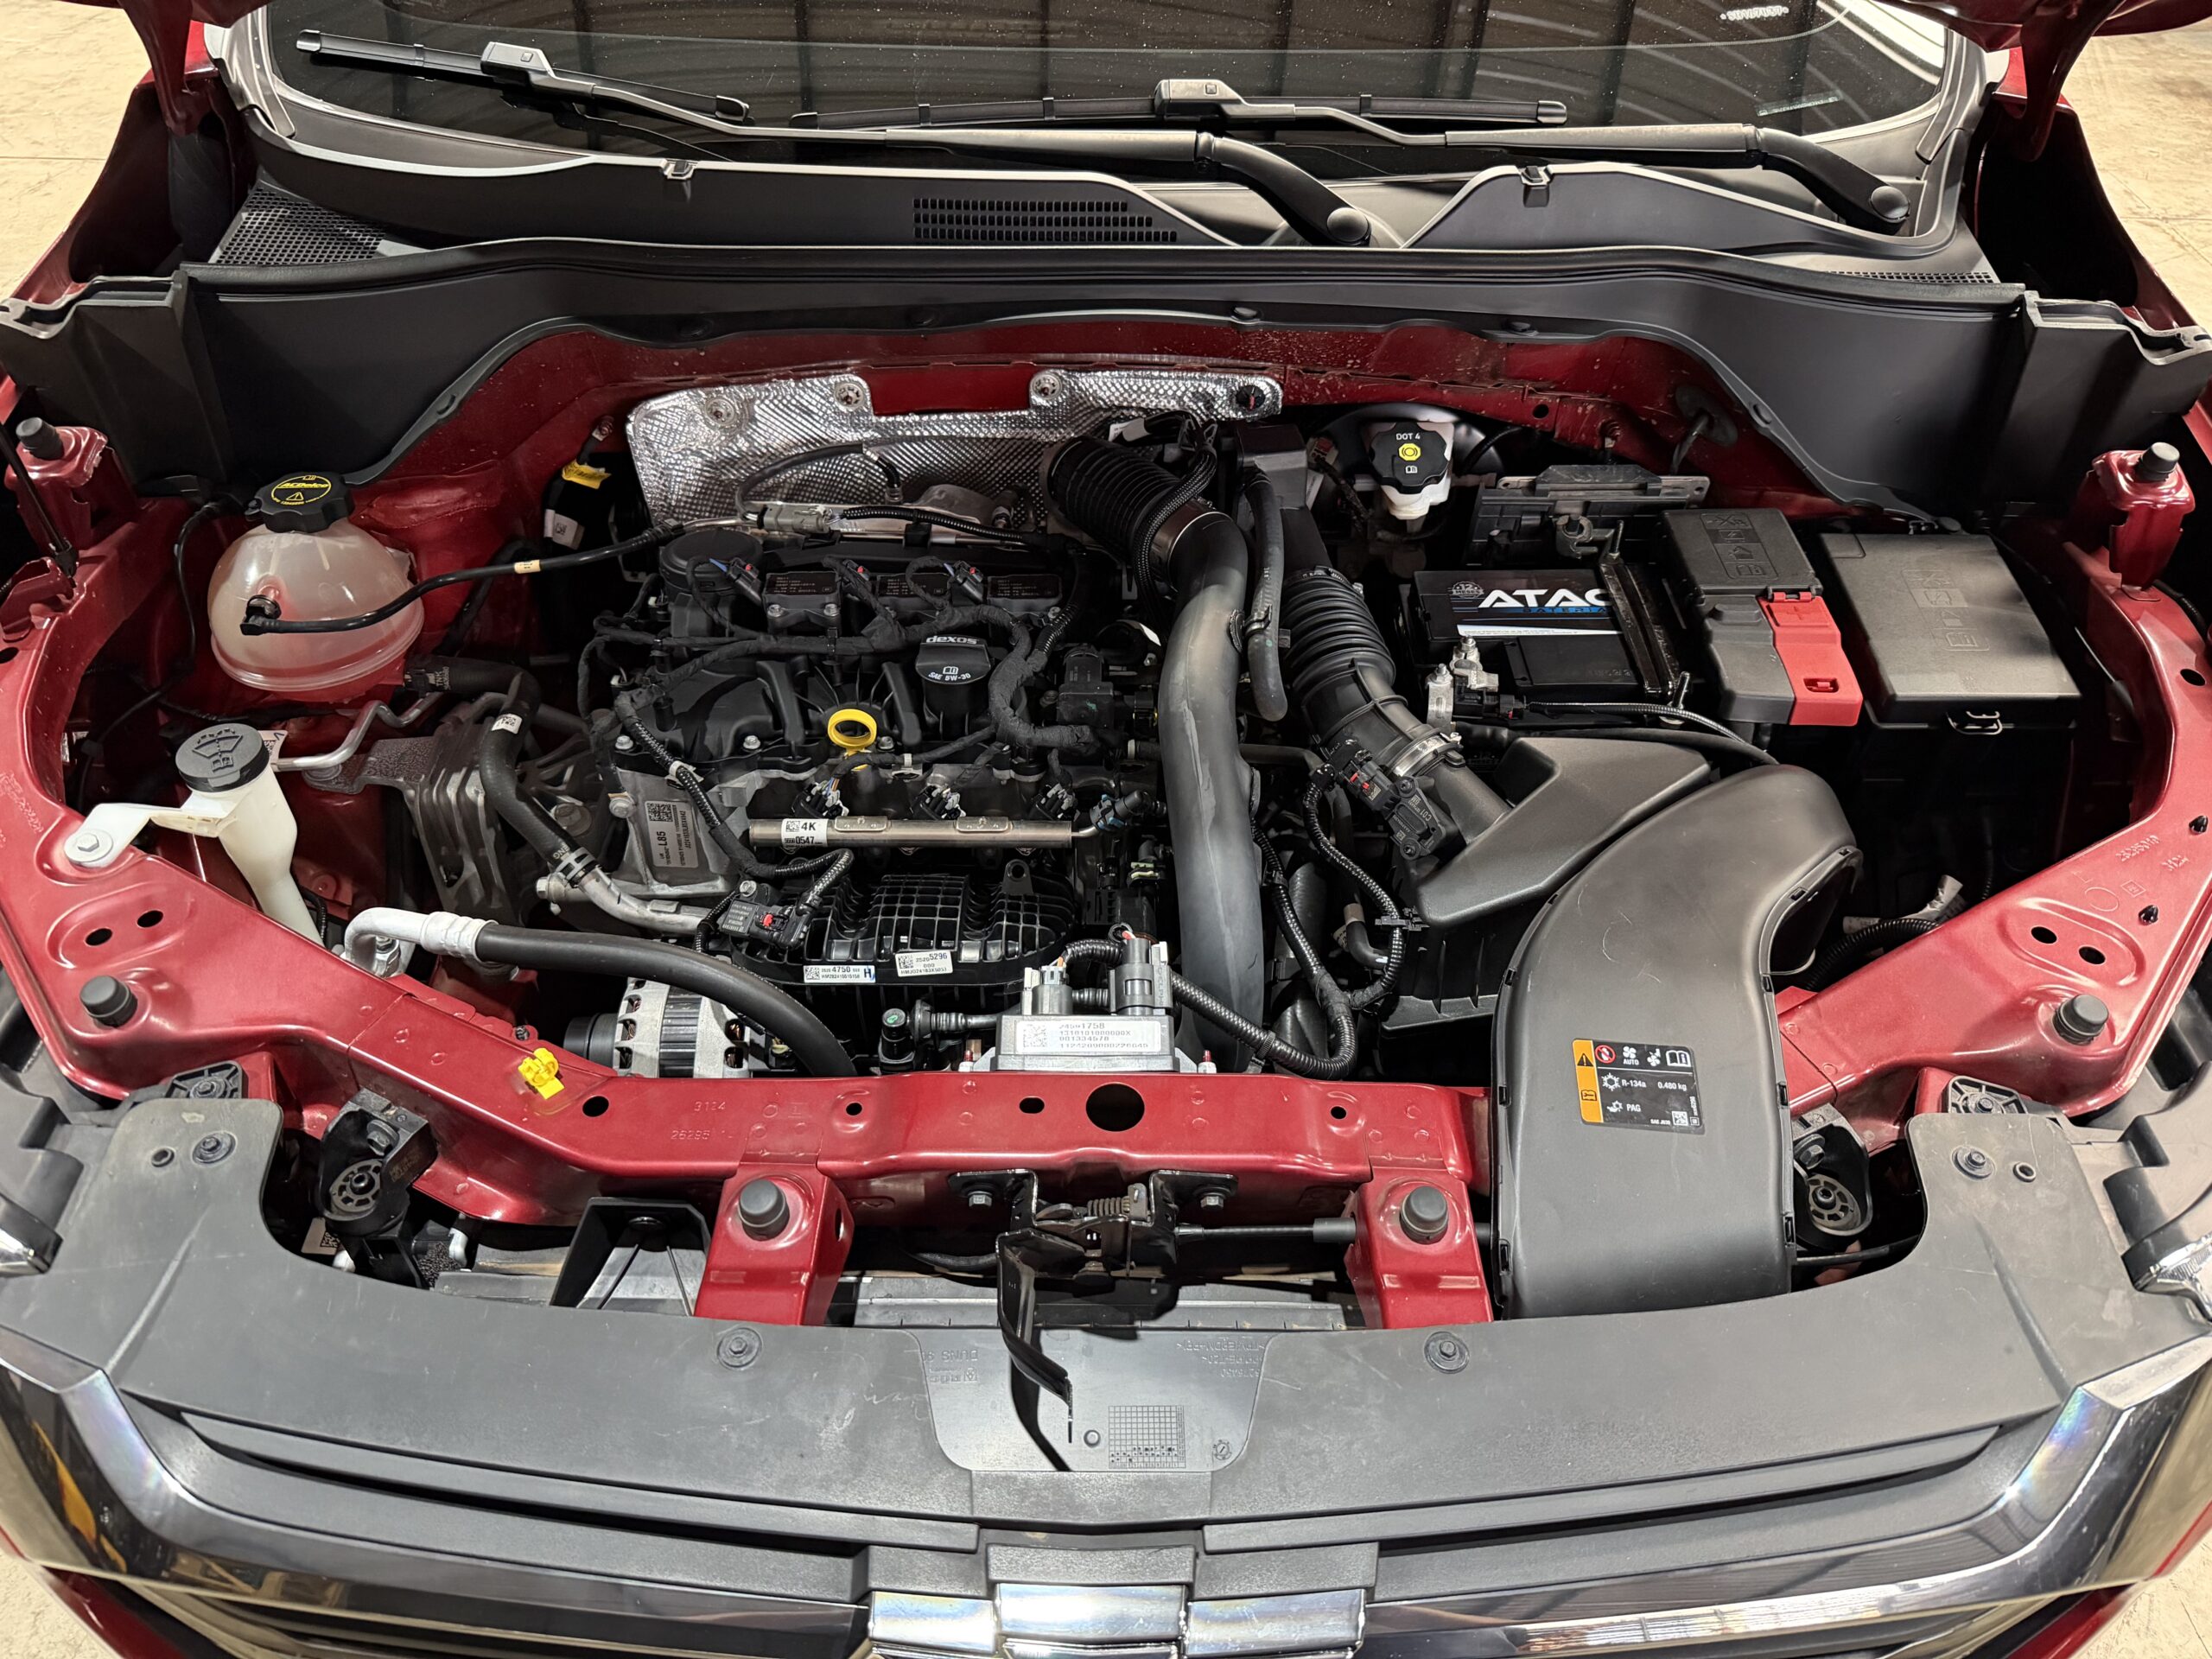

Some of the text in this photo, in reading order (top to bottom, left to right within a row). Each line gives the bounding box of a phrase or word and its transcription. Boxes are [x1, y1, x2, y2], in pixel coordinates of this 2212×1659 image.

[925, 635, 978, 645] dexos
[928, 671, 971, 681] SAE 5W-30
[801, 822, 817, 831] 4K
[656, 830, 667, 847] L85
[863, 968, 872, 978] H
[1621, 1078, 1687, 1091] R-134a 0.480 kg
[1626, 1103, 1642, 1112] PAG
[941, 1349, 978, 1362] DUNS
